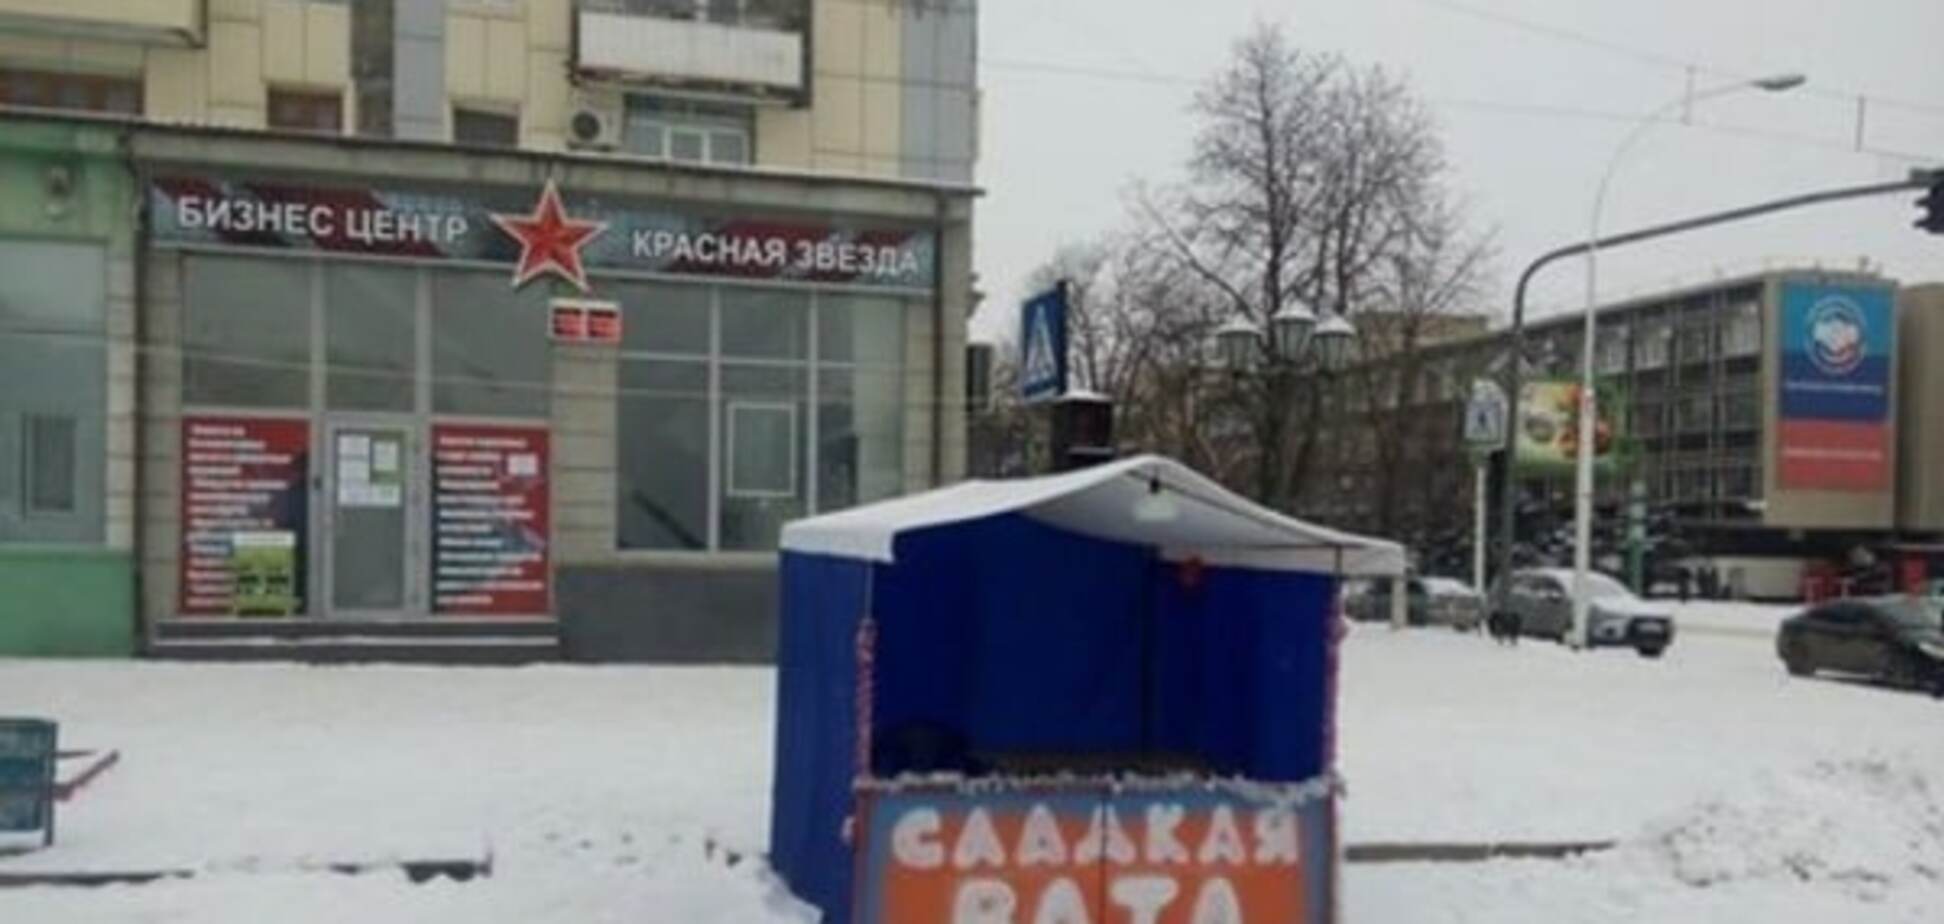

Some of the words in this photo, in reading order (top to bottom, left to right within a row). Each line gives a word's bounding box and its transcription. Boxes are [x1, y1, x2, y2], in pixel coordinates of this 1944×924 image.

[178, 194, 334, 237] БИЗНЕС
[344, 208, 468, 244] ЦЕНТР
[632, 229, 787, 267] КРАСНАЯ
[795, 243, 919, 277] ЗВЕЗДА
[891, 803, 1298, 869] СЛАДКАЯ
